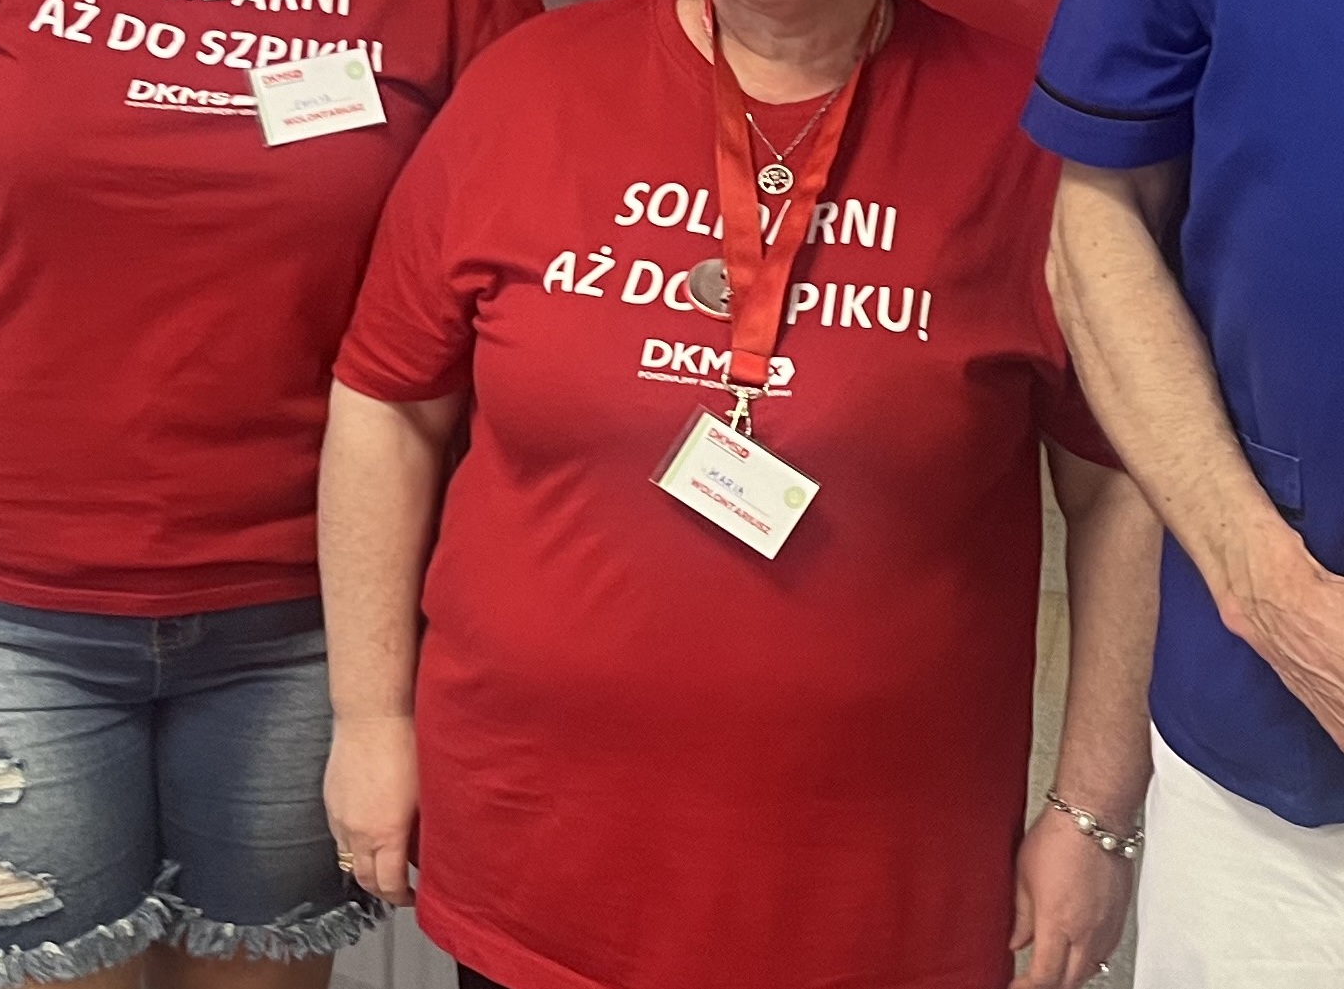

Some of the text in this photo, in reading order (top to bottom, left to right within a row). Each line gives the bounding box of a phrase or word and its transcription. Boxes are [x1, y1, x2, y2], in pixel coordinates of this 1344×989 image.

[106, 12, 186, 60] DO
[126, 78, 231, 106] DKMS
[543, 245, 616, 298] AŻ
[786, 282, 932, 342] PIKU!
[640, 337, 734, 377] DKM
